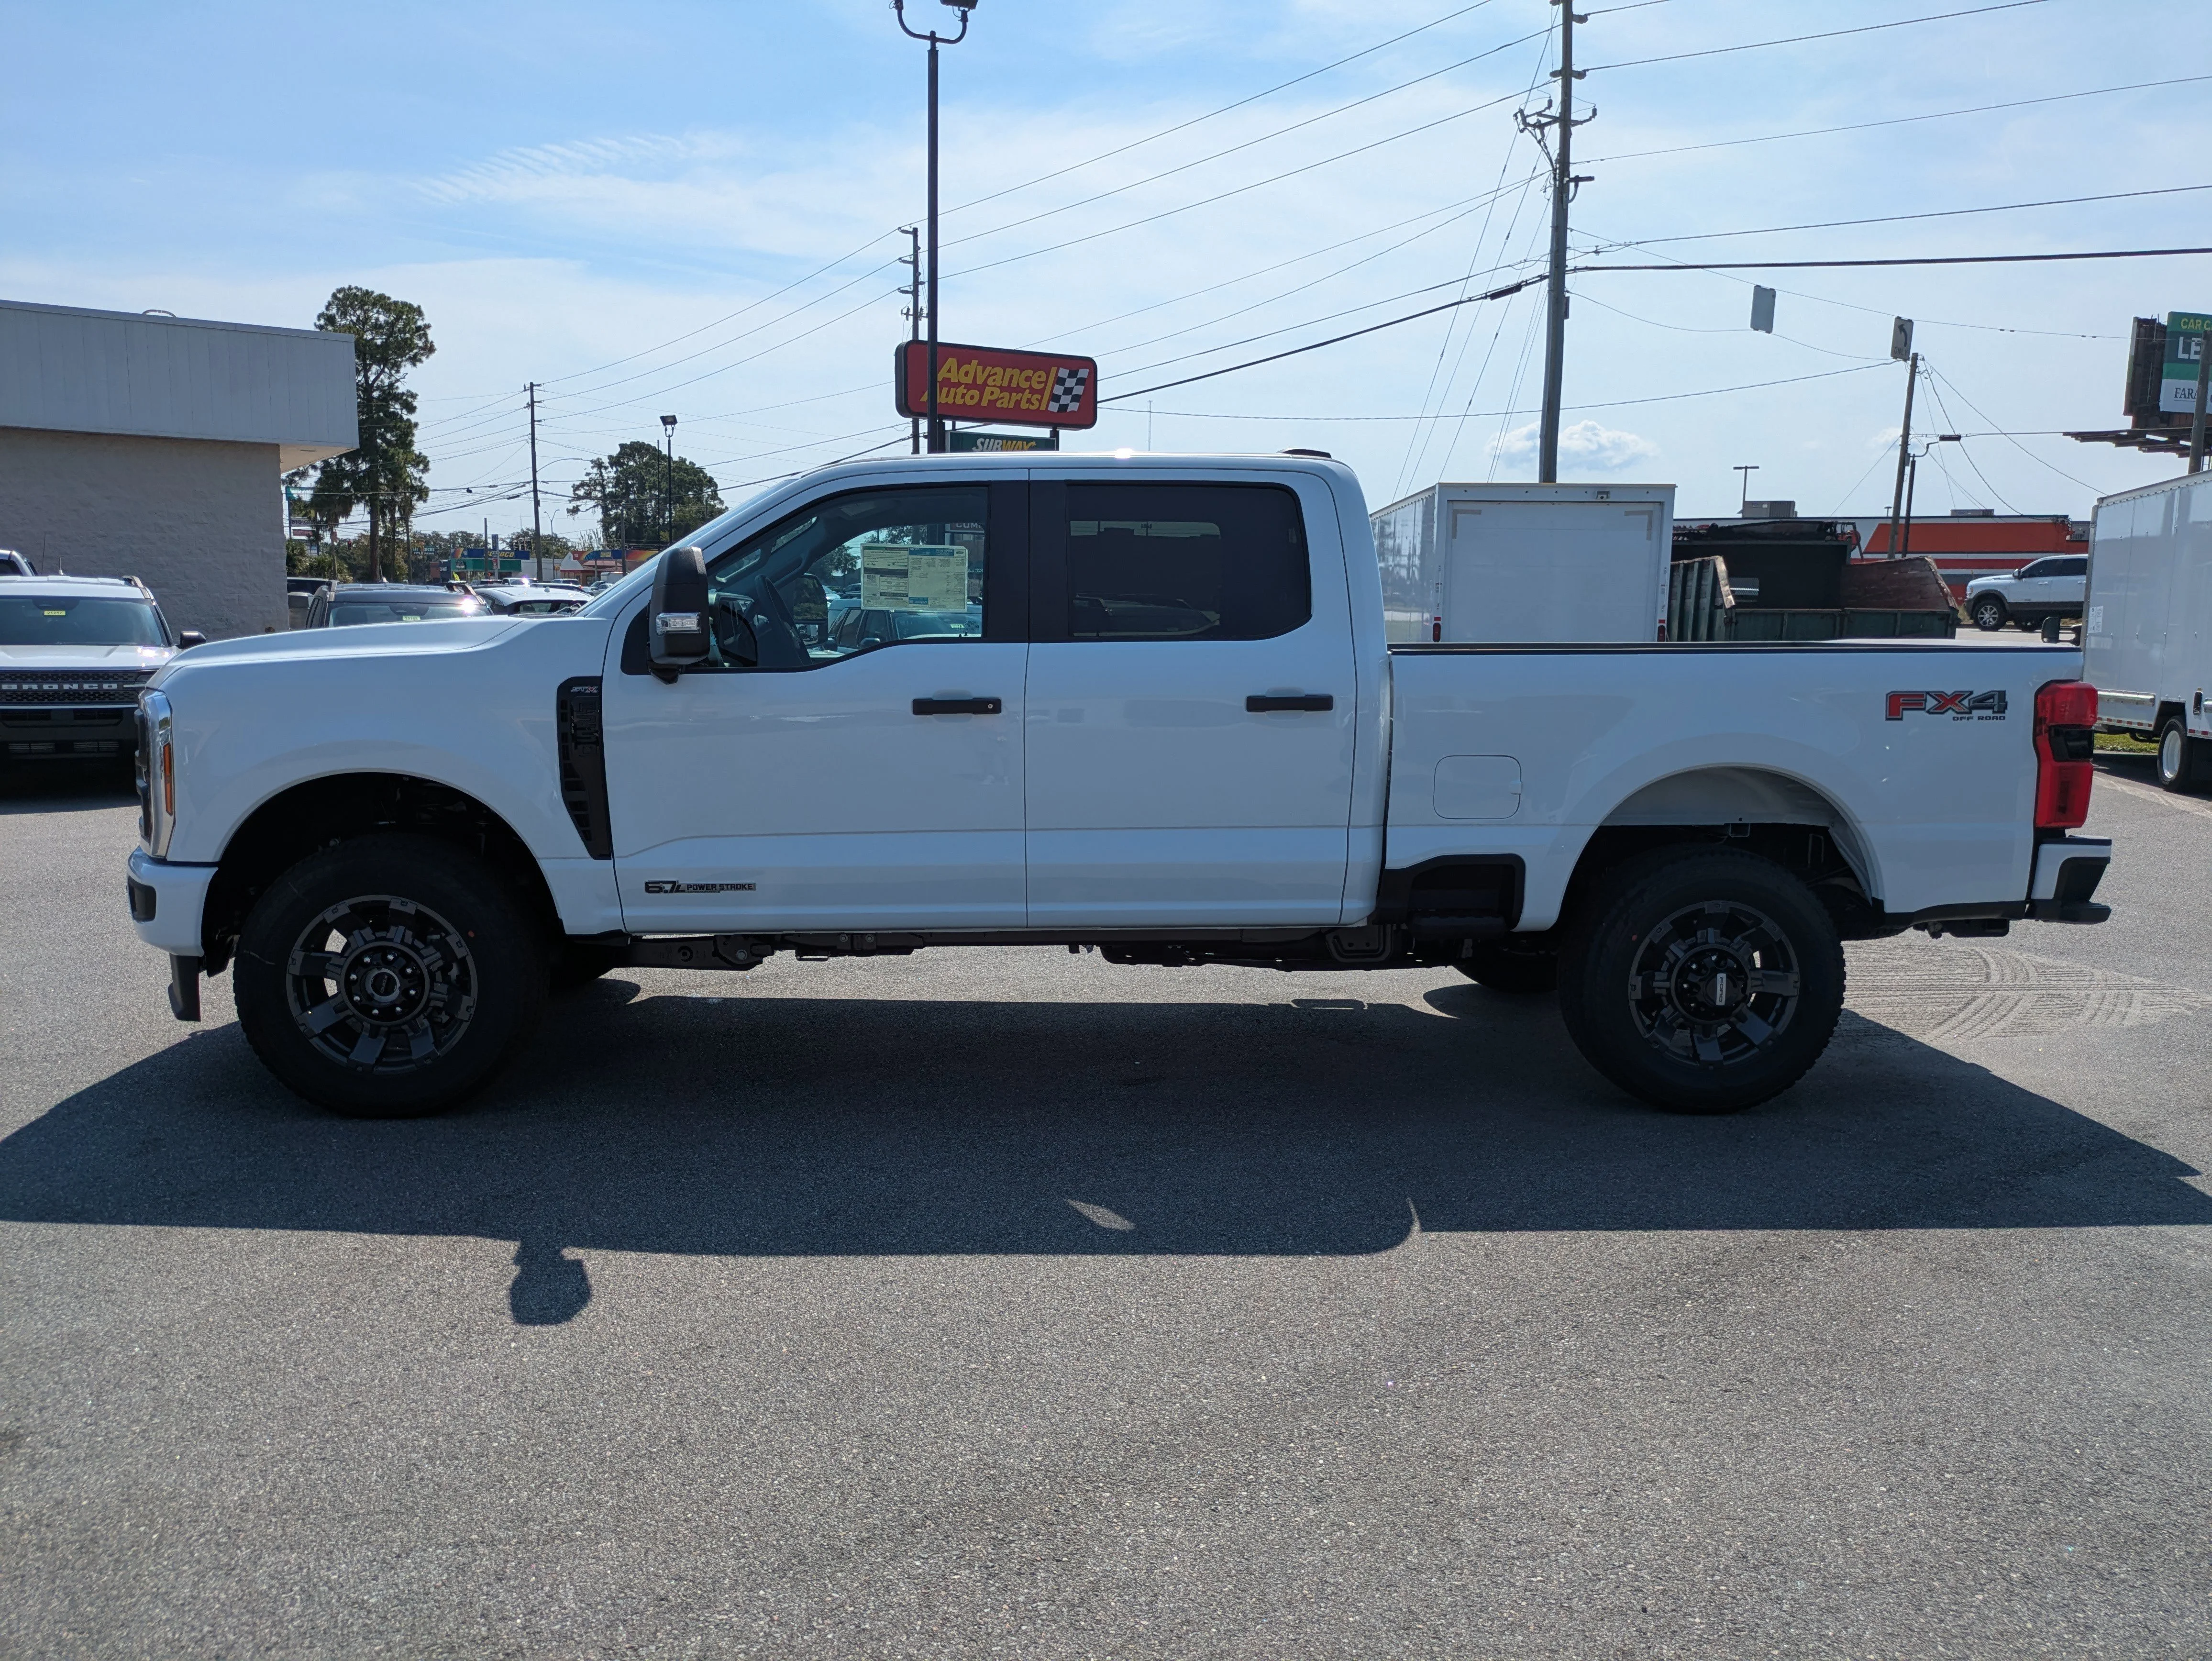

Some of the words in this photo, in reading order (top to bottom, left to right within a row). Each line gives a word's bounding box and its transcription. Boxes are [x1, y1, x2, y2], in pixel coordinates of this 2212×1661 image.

[2180, 318, 2201, 331] CAR
[2204, 320, 2212, 331] C
[1894, 347, 1908, 356] ONLY
[937, 357, 1047, 389] Advance
[981, 387, 1041, 410] Parts
[972, 438, 1036, 452] SUBWAY
[1885, 690, 2008, 721] FX4
